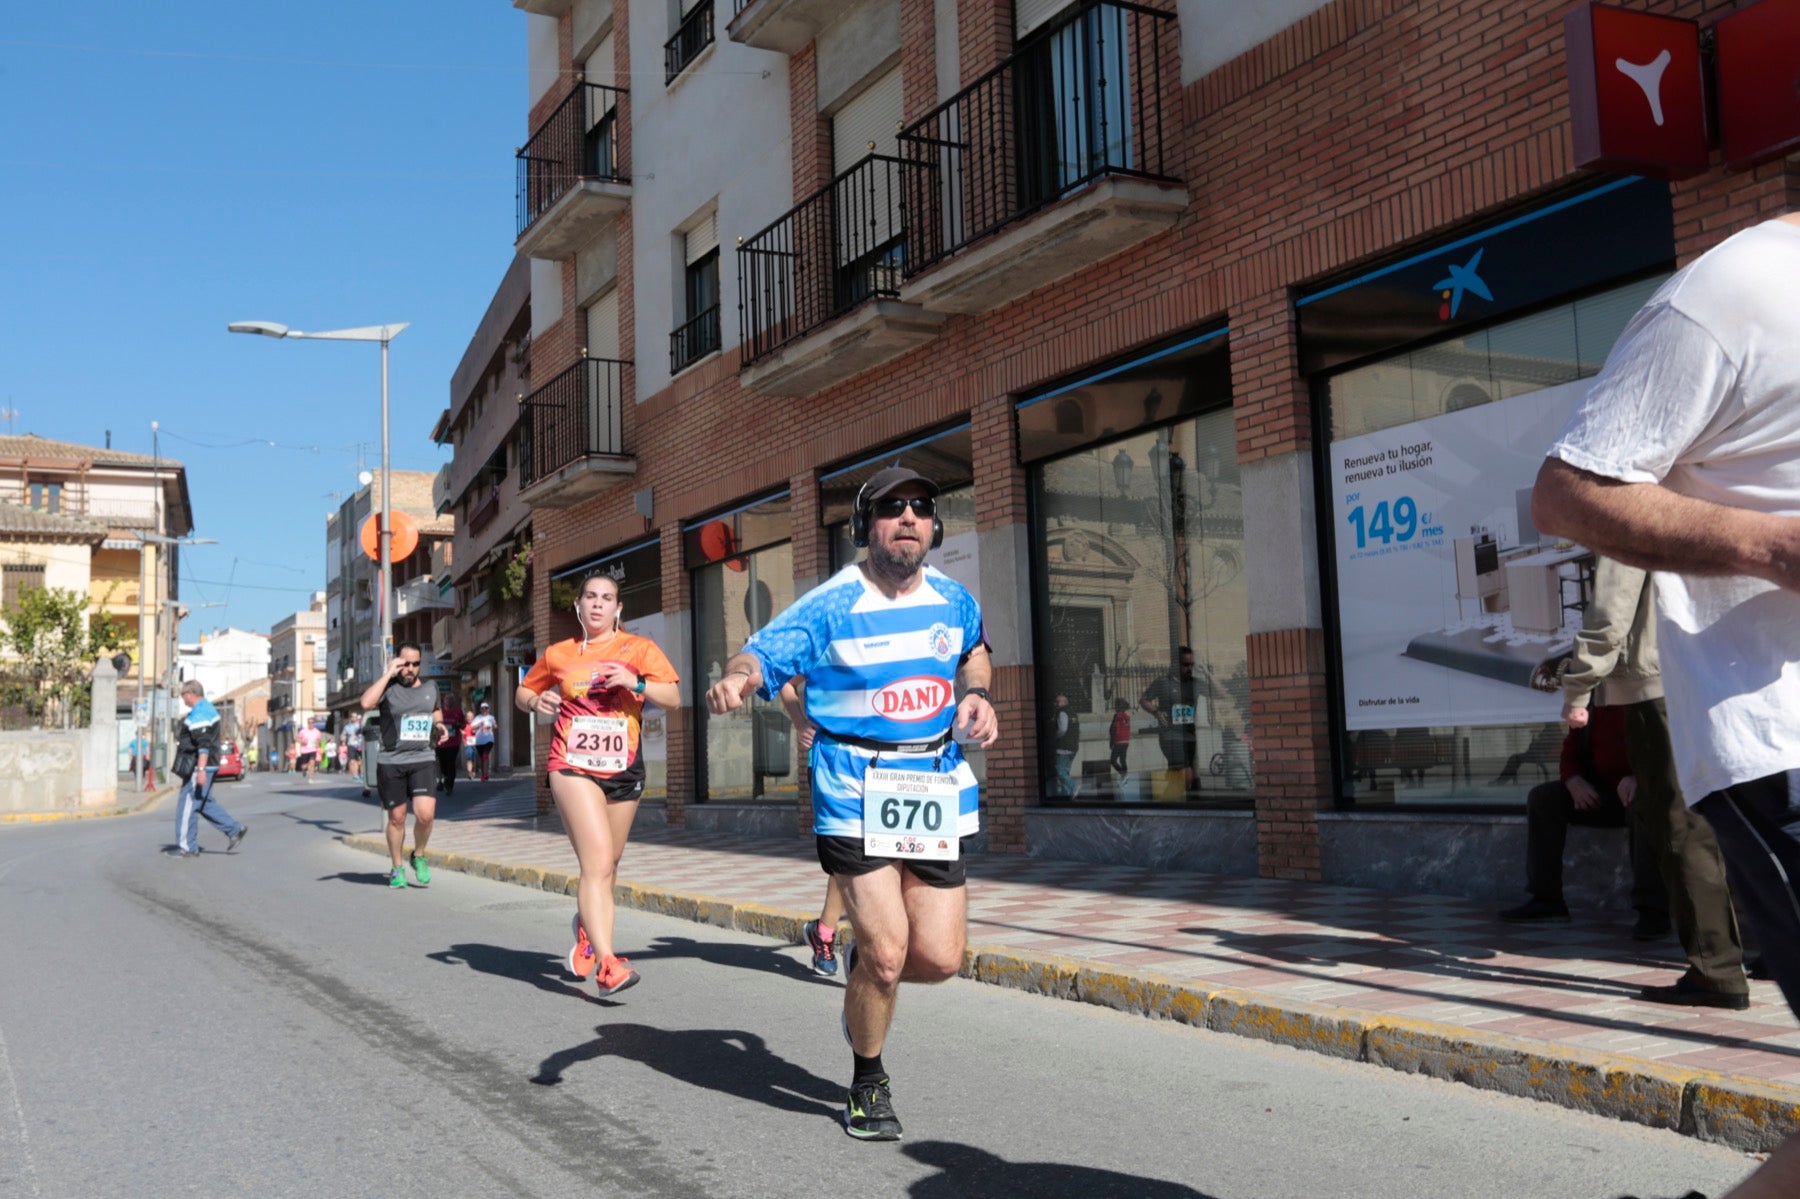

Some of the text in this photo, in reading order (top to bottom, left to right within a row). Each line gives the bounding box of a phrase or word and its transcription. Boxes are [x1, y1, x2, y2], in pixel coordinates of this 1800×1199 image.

[1344, 441, 1433, 470] Renueva tu hogar,
[1345, 454, 1433, 484] renueva tu ilusión
[1346, 492, 1360, 504] por
[1347, 496, 1417, 549] 149
[1422, 525, 1444, 538] mes
[882, 685, 938, 713] DANI
[1359, 695, 1420, 707] Disfrutar de la vida
[408, 720, 429, 731] 532
[576, 733, 623, 752] 2310
[890, 772, 905, 782] GRAN
[906, 773, 926, 783] PREMIO
[926, 775, 934, 784] DE
[880, 797, 942, 832] 670
